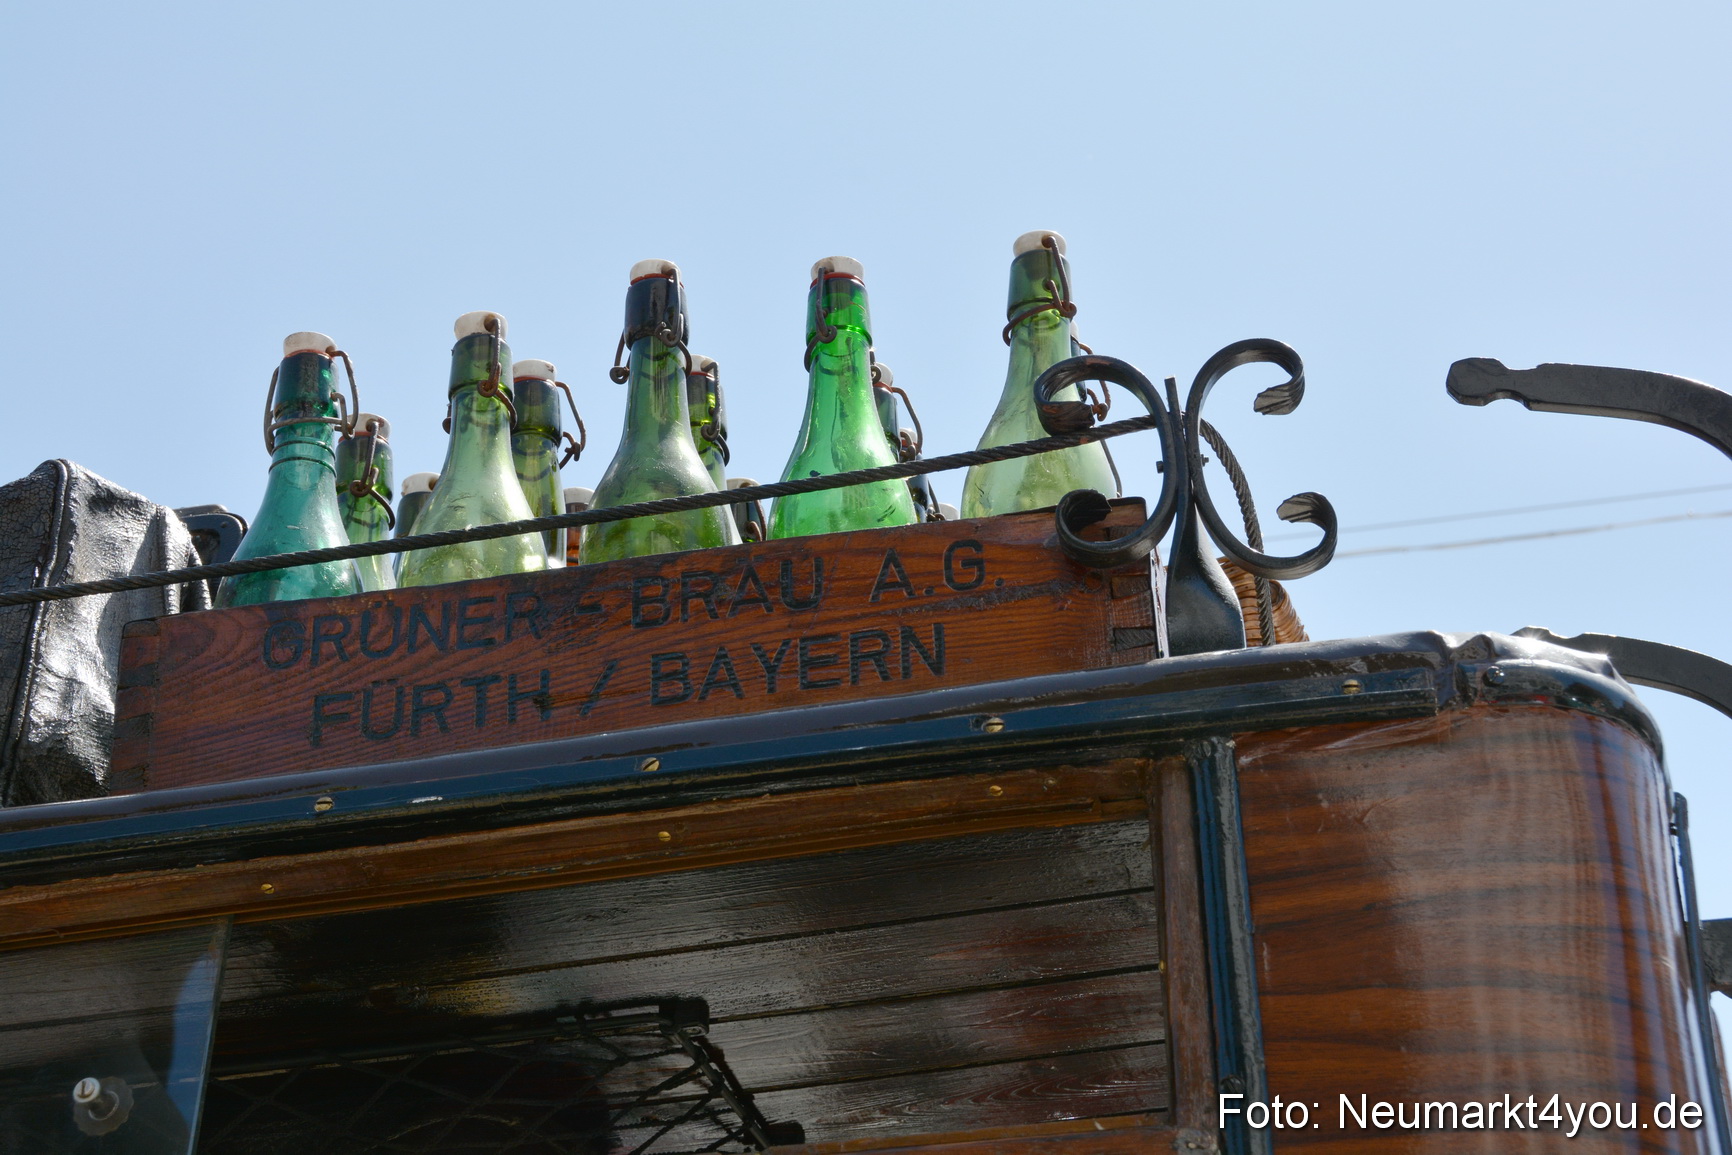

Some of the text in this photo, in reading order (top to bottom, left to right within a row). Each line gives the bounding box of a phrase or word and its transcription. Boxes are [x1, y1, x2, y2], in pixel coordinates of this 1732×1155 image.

[262, 591, 544, 670] GRÜNER
[631, 555, 824, 629] BRÄU
[870, 539, 1005, 602] A.G.
[309, 623, 946, 747] FÜRTH / BAYERN
